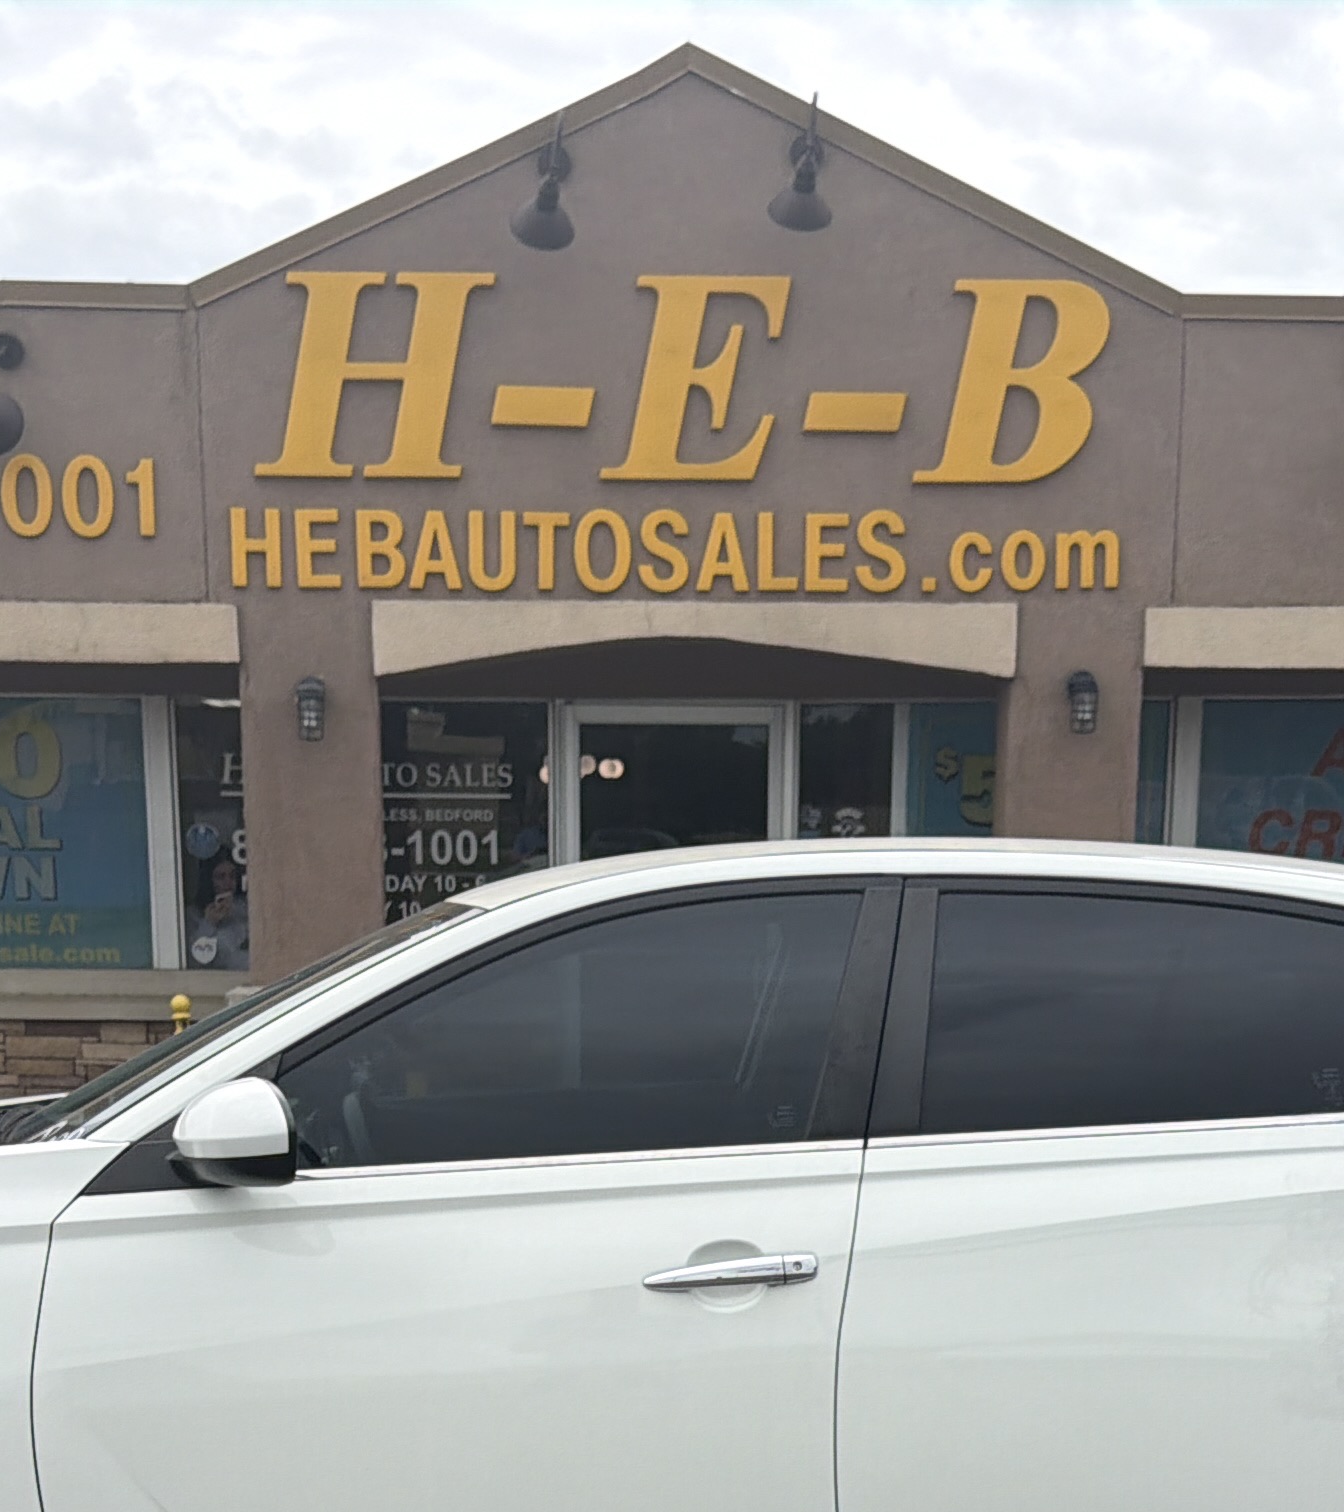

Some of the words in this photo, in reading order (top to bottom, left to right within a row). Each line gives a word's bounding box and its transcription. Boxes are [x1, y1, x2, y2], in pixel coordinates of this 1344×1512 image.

[254, 271, 1111, 485] H-E-B
[229, 506, 1120, 594] HEBAUTOSALES.com
[383, 762, 418, 787] TO
[425, 761, 514, 788] SALES
[934, 747, 996, 828] $5
[425, 808, 494, 822] BEDFORD
[385, 874, 427, 893] DAY
[434, 874, 456, 893] 10
[47, 914, 80, 935] AT
